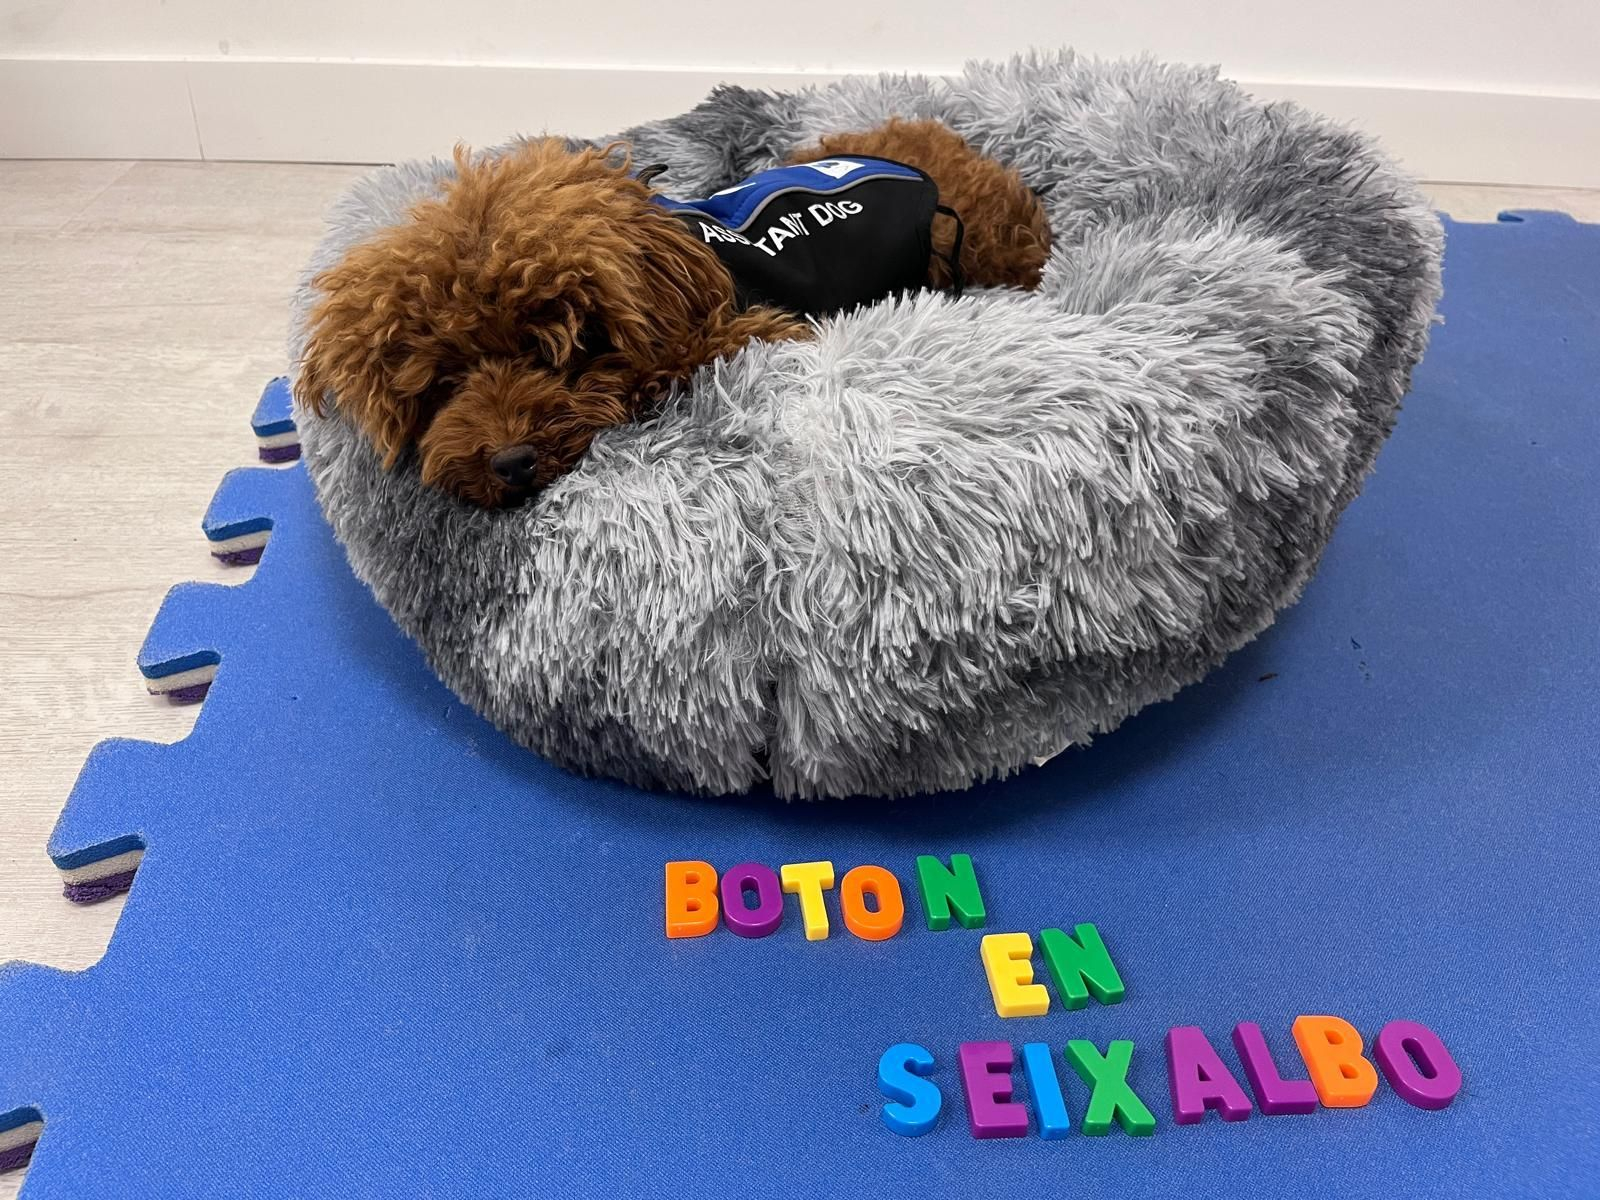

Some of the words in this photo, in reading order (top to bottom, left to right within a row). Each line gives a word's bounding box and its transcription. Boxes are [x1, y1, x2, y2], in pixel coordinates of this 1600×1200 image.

[699, 212, 809, 257] ASSTANT
[808, 201, 863, 226] DOG
[665, 853, 987, 941] BOTON
[980, 923, 1125, 1018] EN
[878, 1015, 1463, 1138] SEIXALBO
